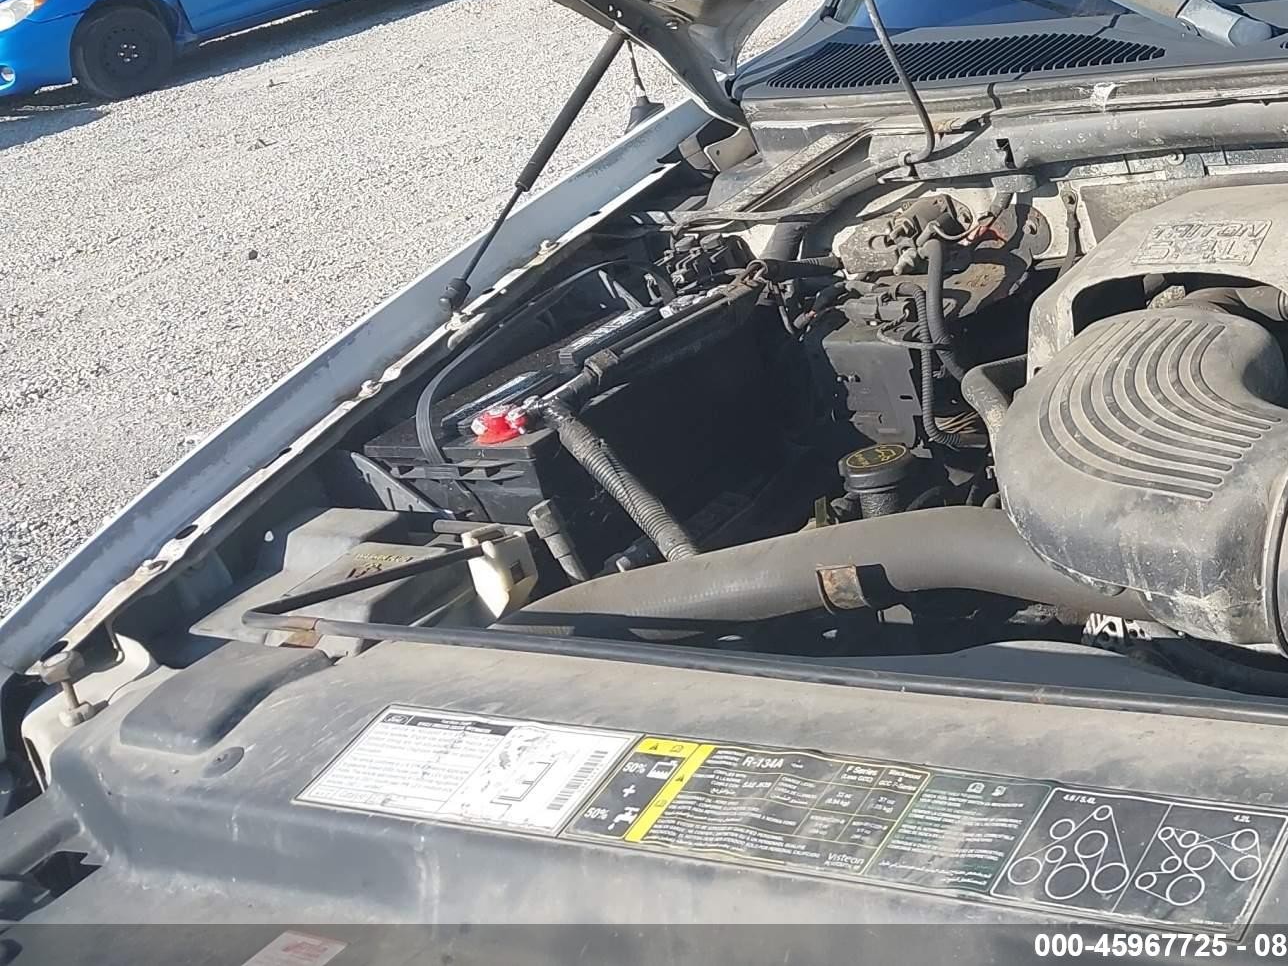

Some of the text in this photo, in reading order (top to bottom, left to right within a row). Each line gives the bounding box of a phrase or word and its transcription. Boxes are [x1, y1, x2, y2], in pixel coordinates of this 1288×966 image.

[1152, 222, 1267, 239] TRITON
[622, 761, 648, 774] 50%
[742, 755, 785, 769] R-134A
[853, 766, 878, 776] Series
[584, 807, 610, 820] 50%
[828, 853, 865, 865] Visteon
